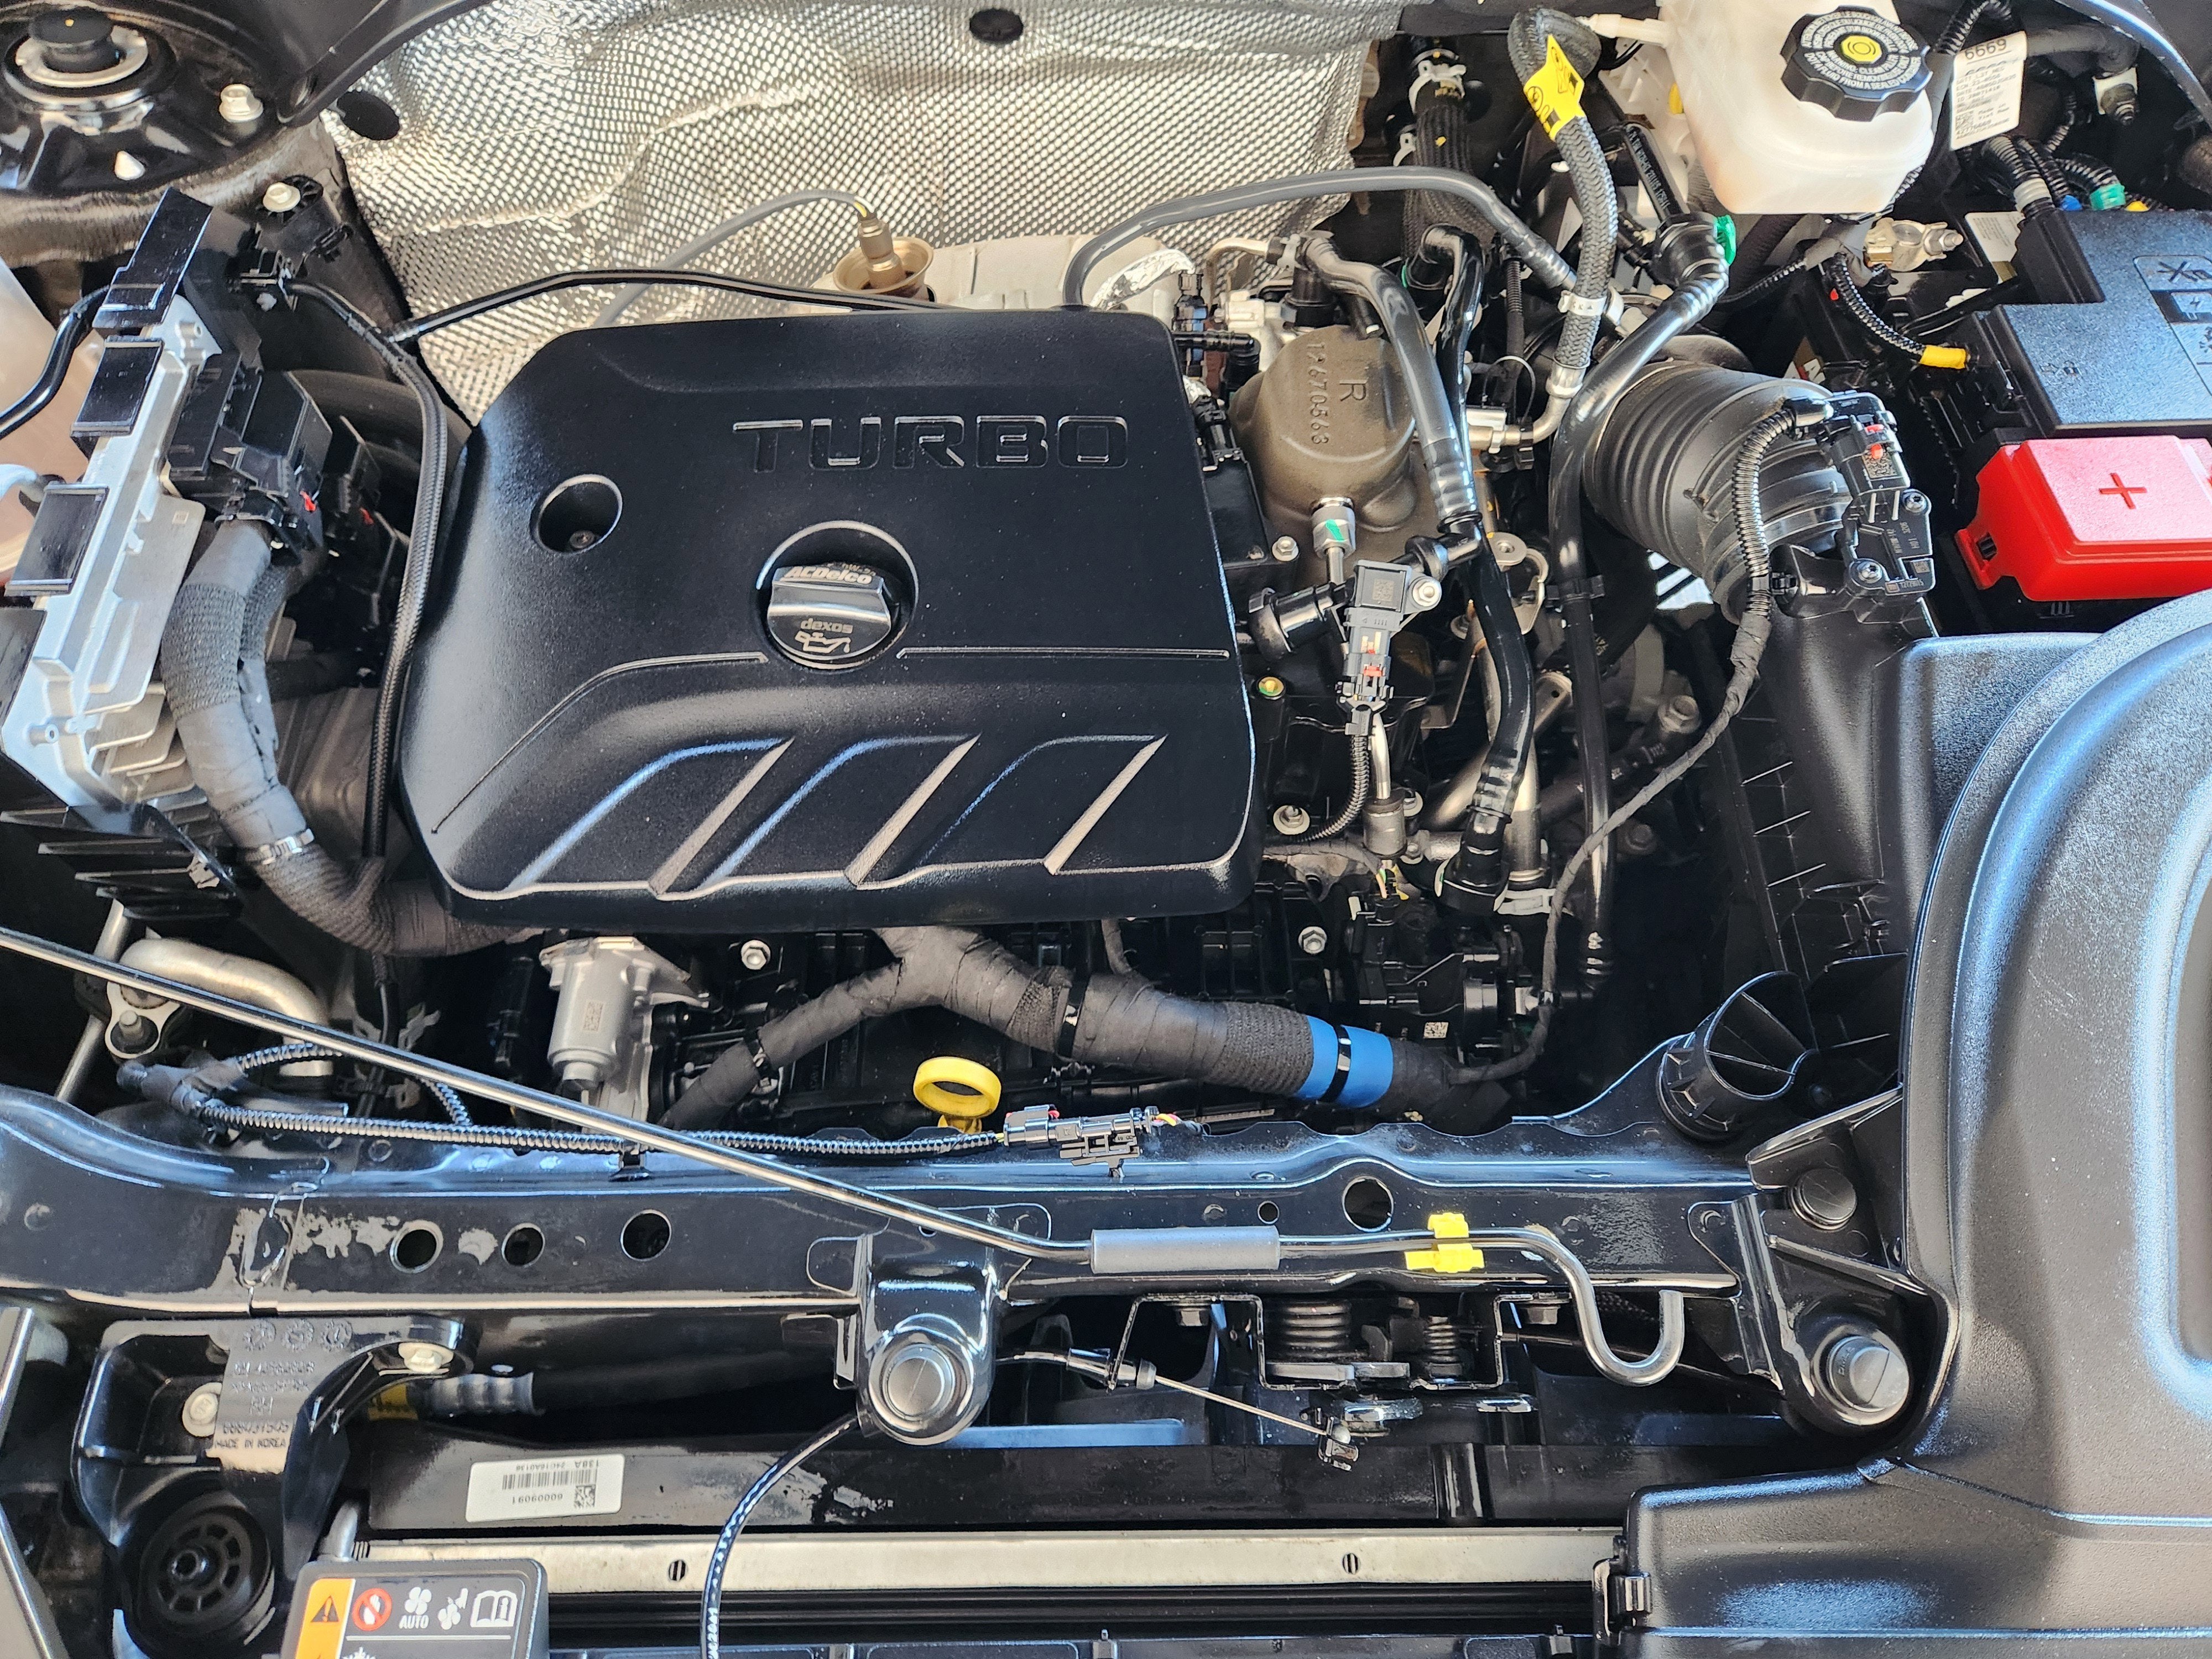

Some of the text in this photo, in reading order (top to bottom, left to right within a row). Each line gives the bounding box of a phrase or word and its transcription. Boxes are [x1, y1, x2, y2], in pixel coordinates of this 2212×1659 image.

[1965, 39, 2007, 60] 6669
[1339, 379, 1367, 401] R
[732, 415, 1129, 473] TURBO
[783, 566, 874, 584] ACDelco
[800, 618, 854, 634] dexos
[215, 1437, 287, 1449] MADE IN KOREA
[399, 1614, 430, 1629] AUTO
